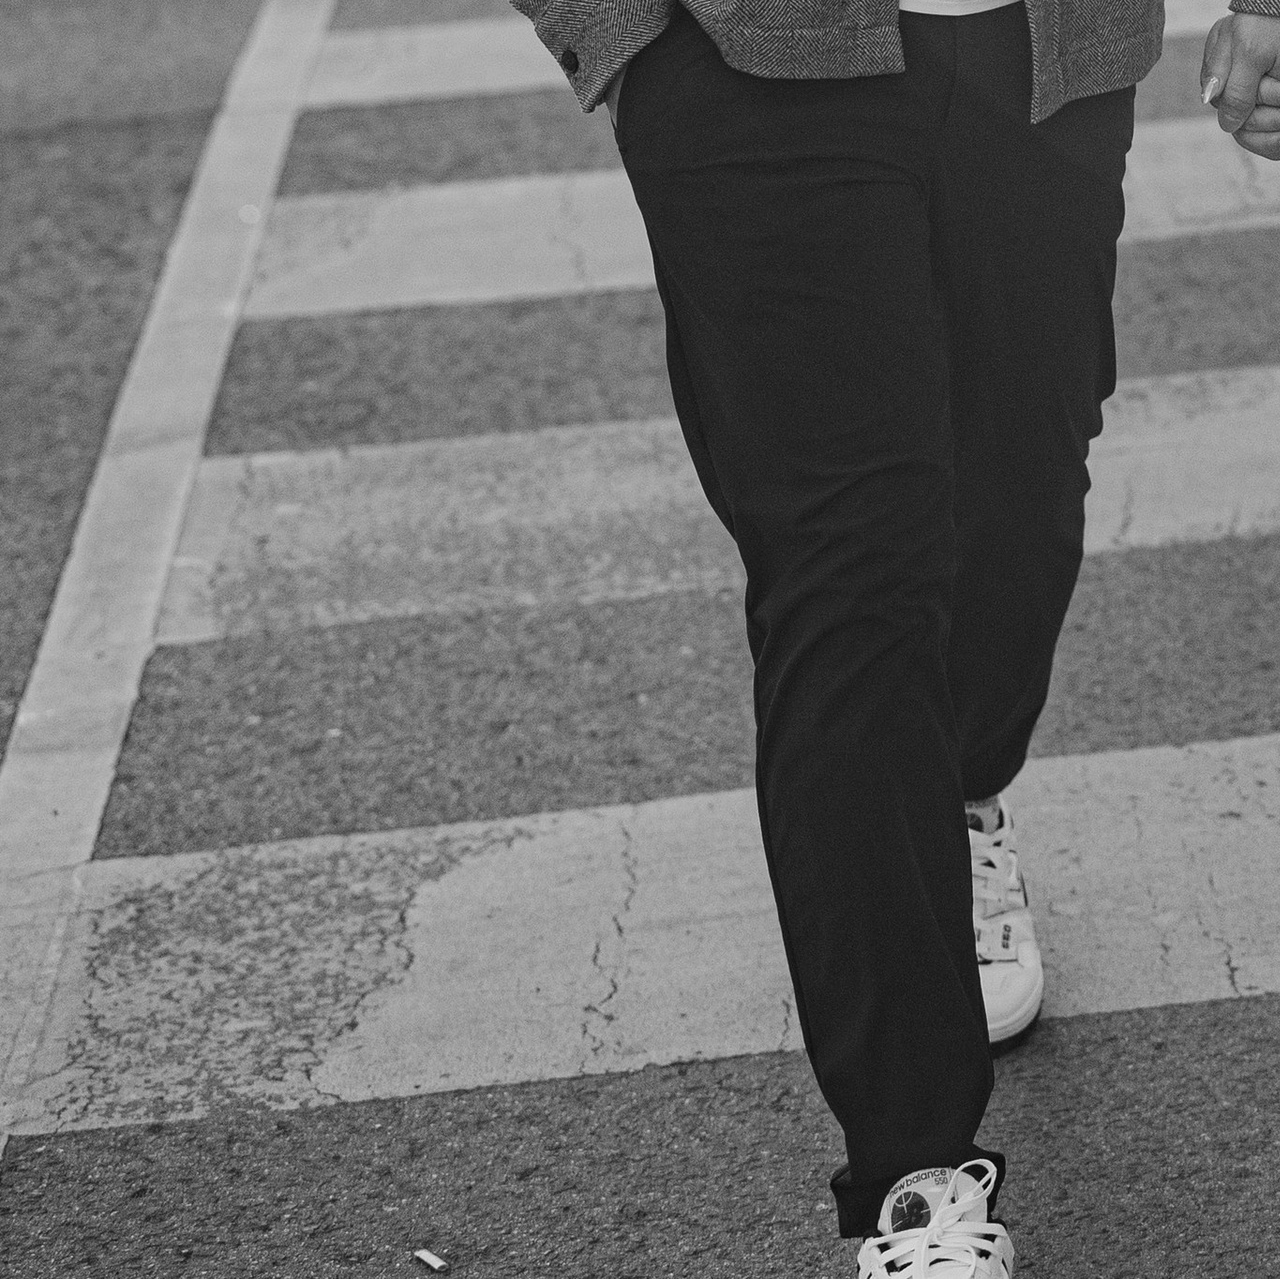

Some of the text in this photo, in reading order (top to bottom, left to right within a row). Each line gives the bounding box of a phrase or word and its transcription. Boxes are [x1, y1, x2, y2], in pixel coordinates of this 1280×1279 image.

[889, 1168, 947, 1198] new balance
[934, 1177, 948, 1186] 550
